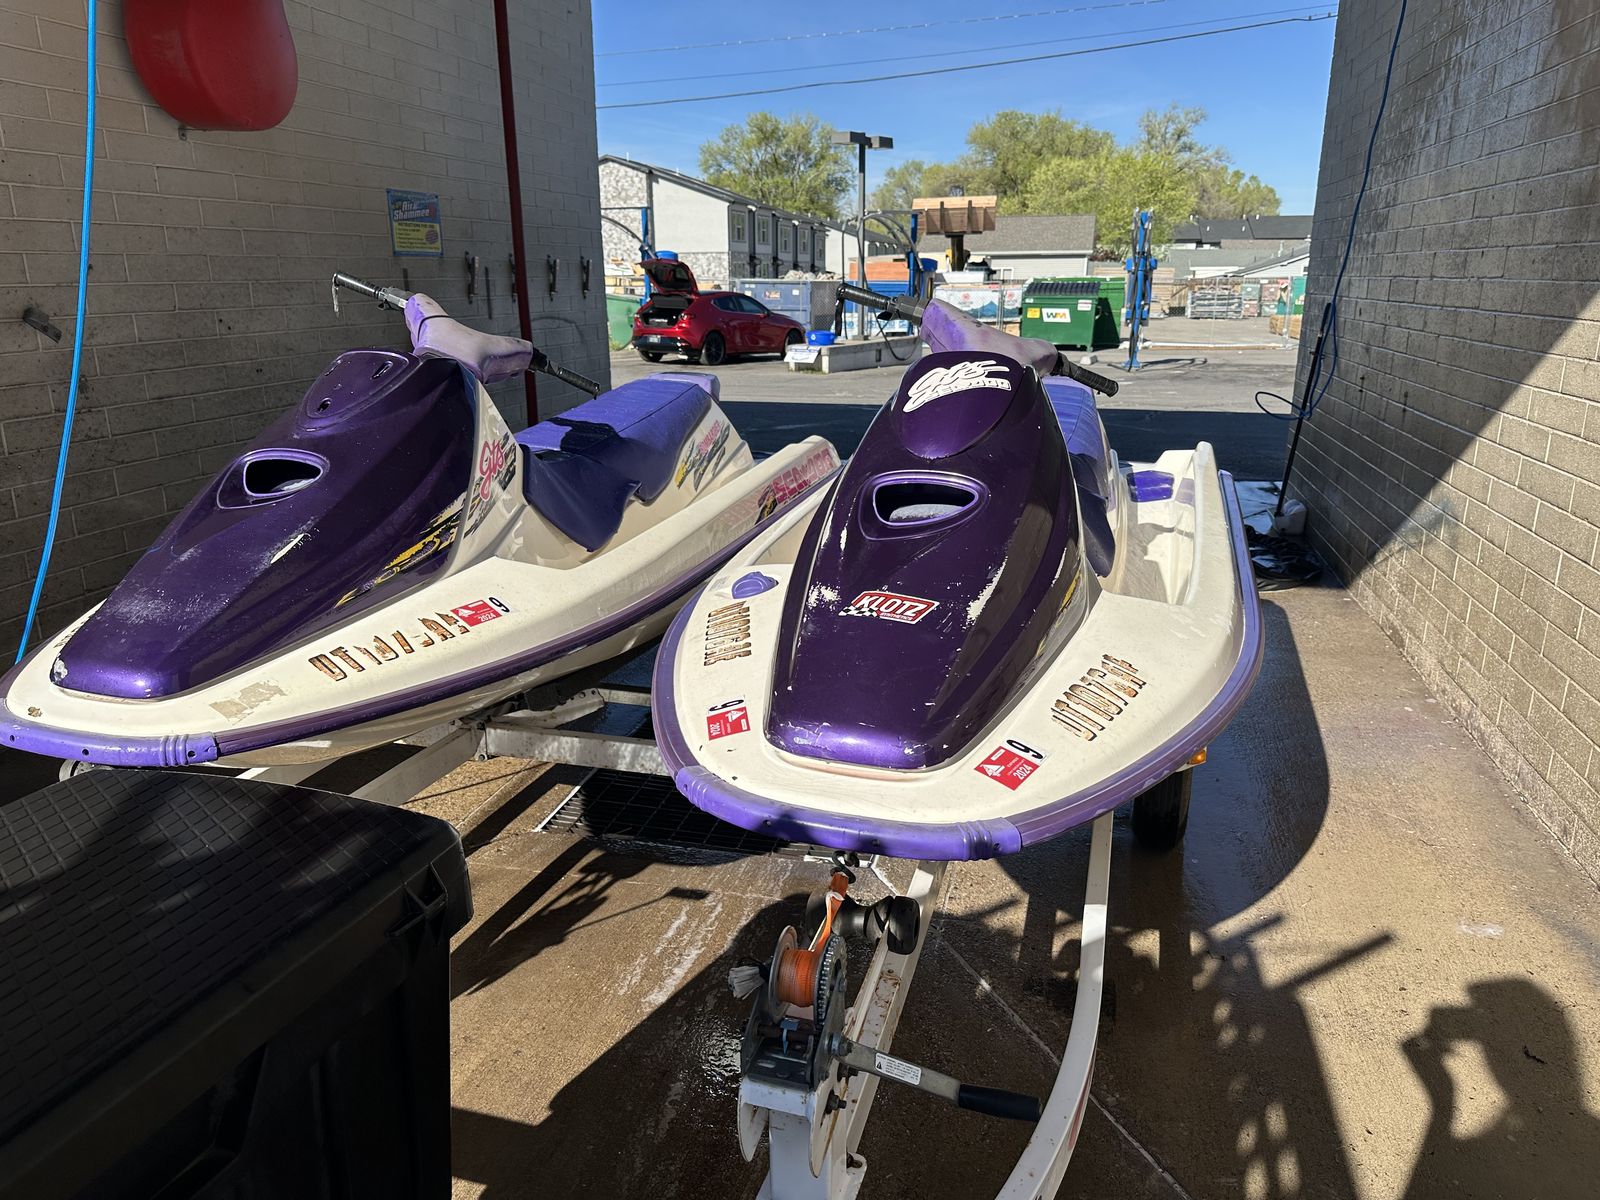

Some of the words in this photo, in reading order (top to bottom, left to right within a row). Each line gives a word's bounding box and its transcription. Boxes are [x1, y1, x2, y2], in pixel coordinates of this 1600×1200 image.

[1046, 312, 1067, 320] WM
[488, 596, 511, 613] 9
[853, 594, 928, 618] KLOTZ
[478, 612, 497, 623] 2024
[1006, 738, 1044, 760] 9
[1012, 763, 1034, 781] 2024
